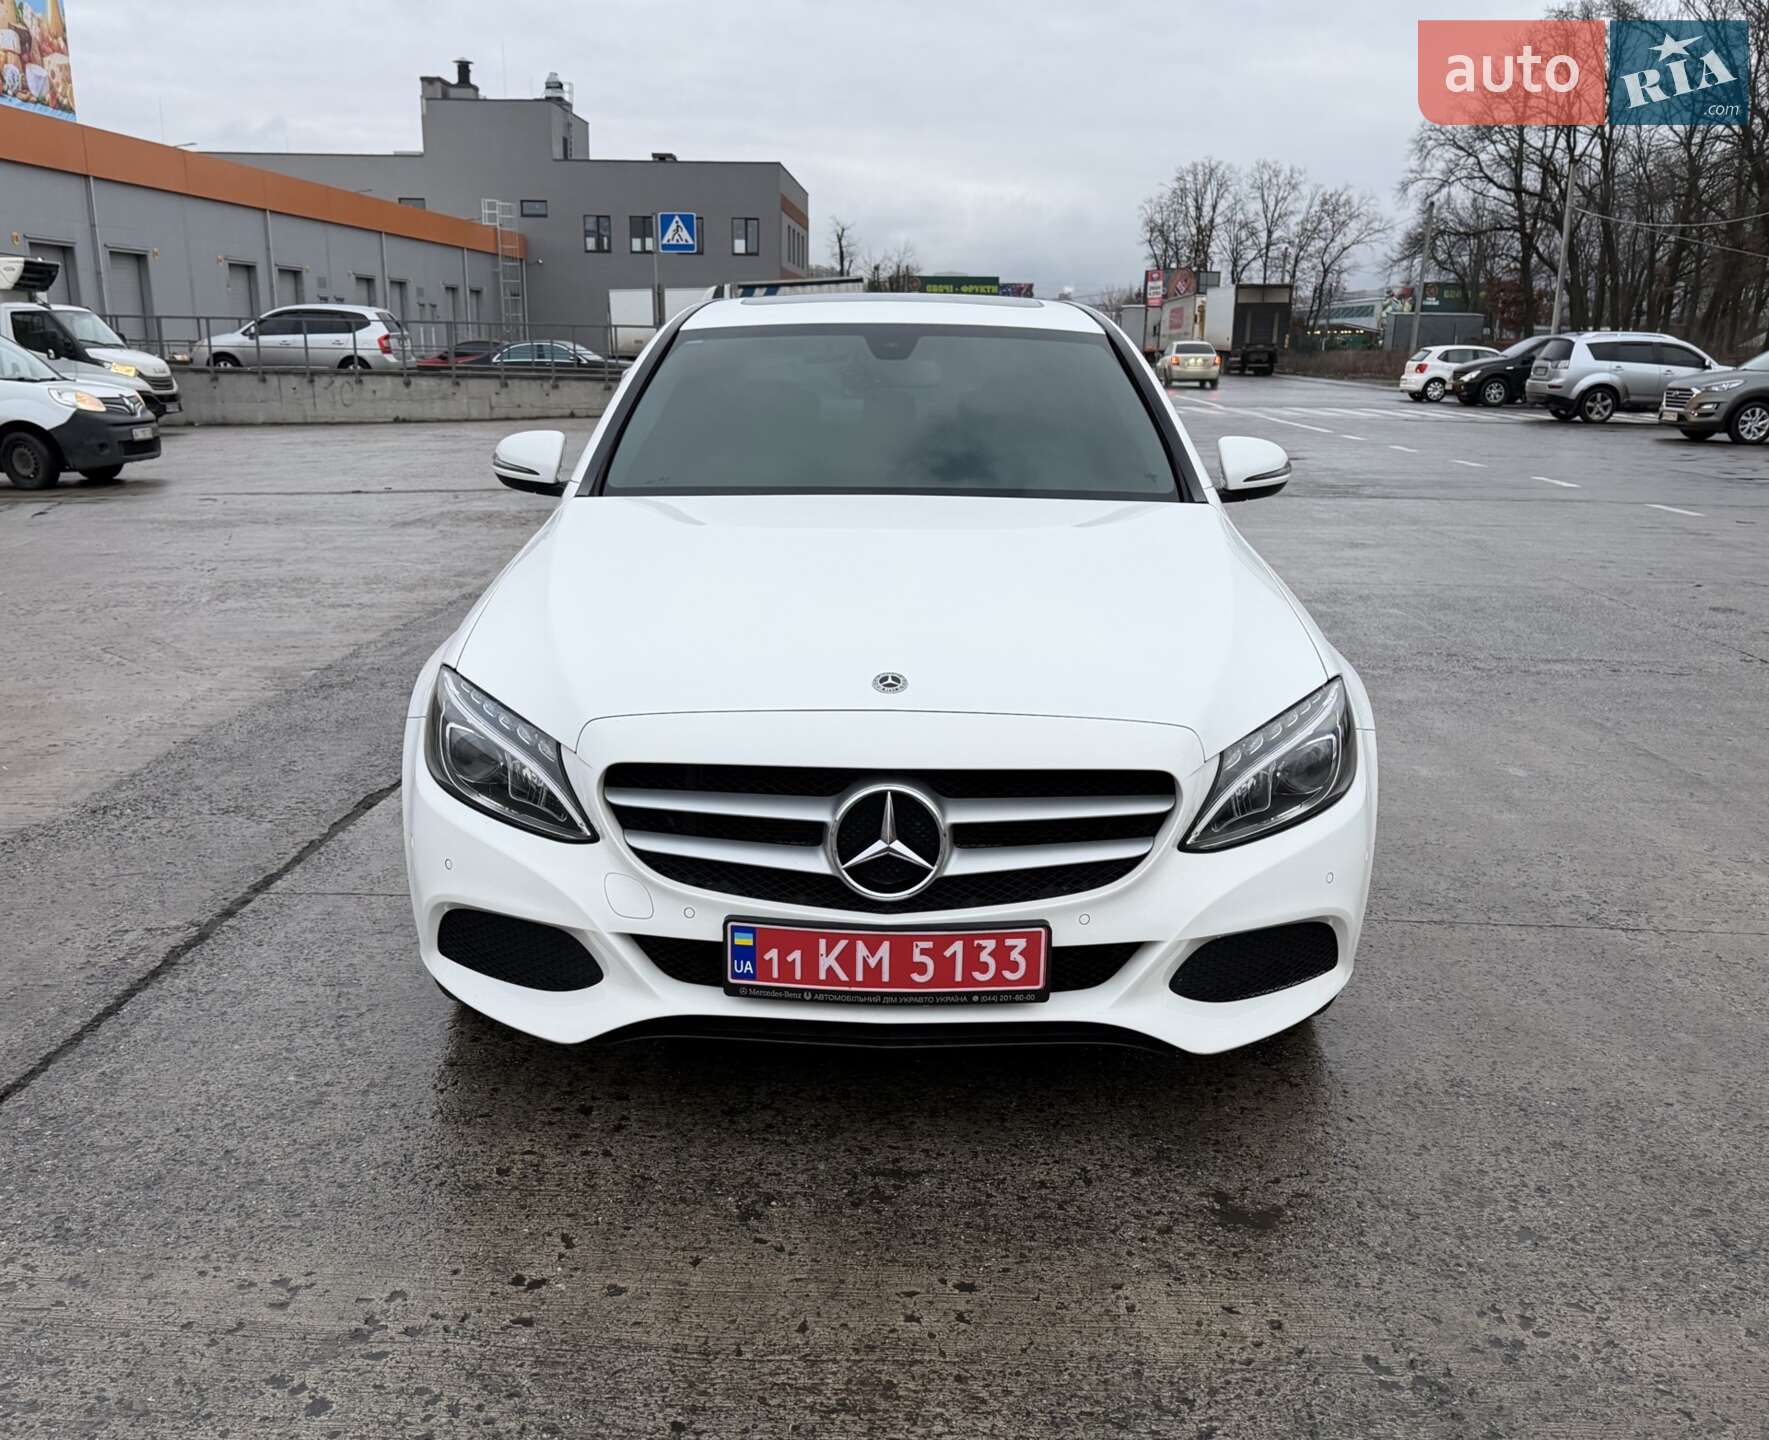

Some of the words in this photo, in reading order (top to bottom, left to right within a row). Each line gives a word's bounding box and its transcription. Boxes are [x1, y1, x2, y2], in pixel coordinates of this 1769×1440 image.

[734, 959, 754, 974] UA
[763, 948, 801, 980] 11
[818, 938, 890, 982] KM
[910, 938, 1027, 982] 5133
[749, 988, 802, 999] Mercedes-Benz
